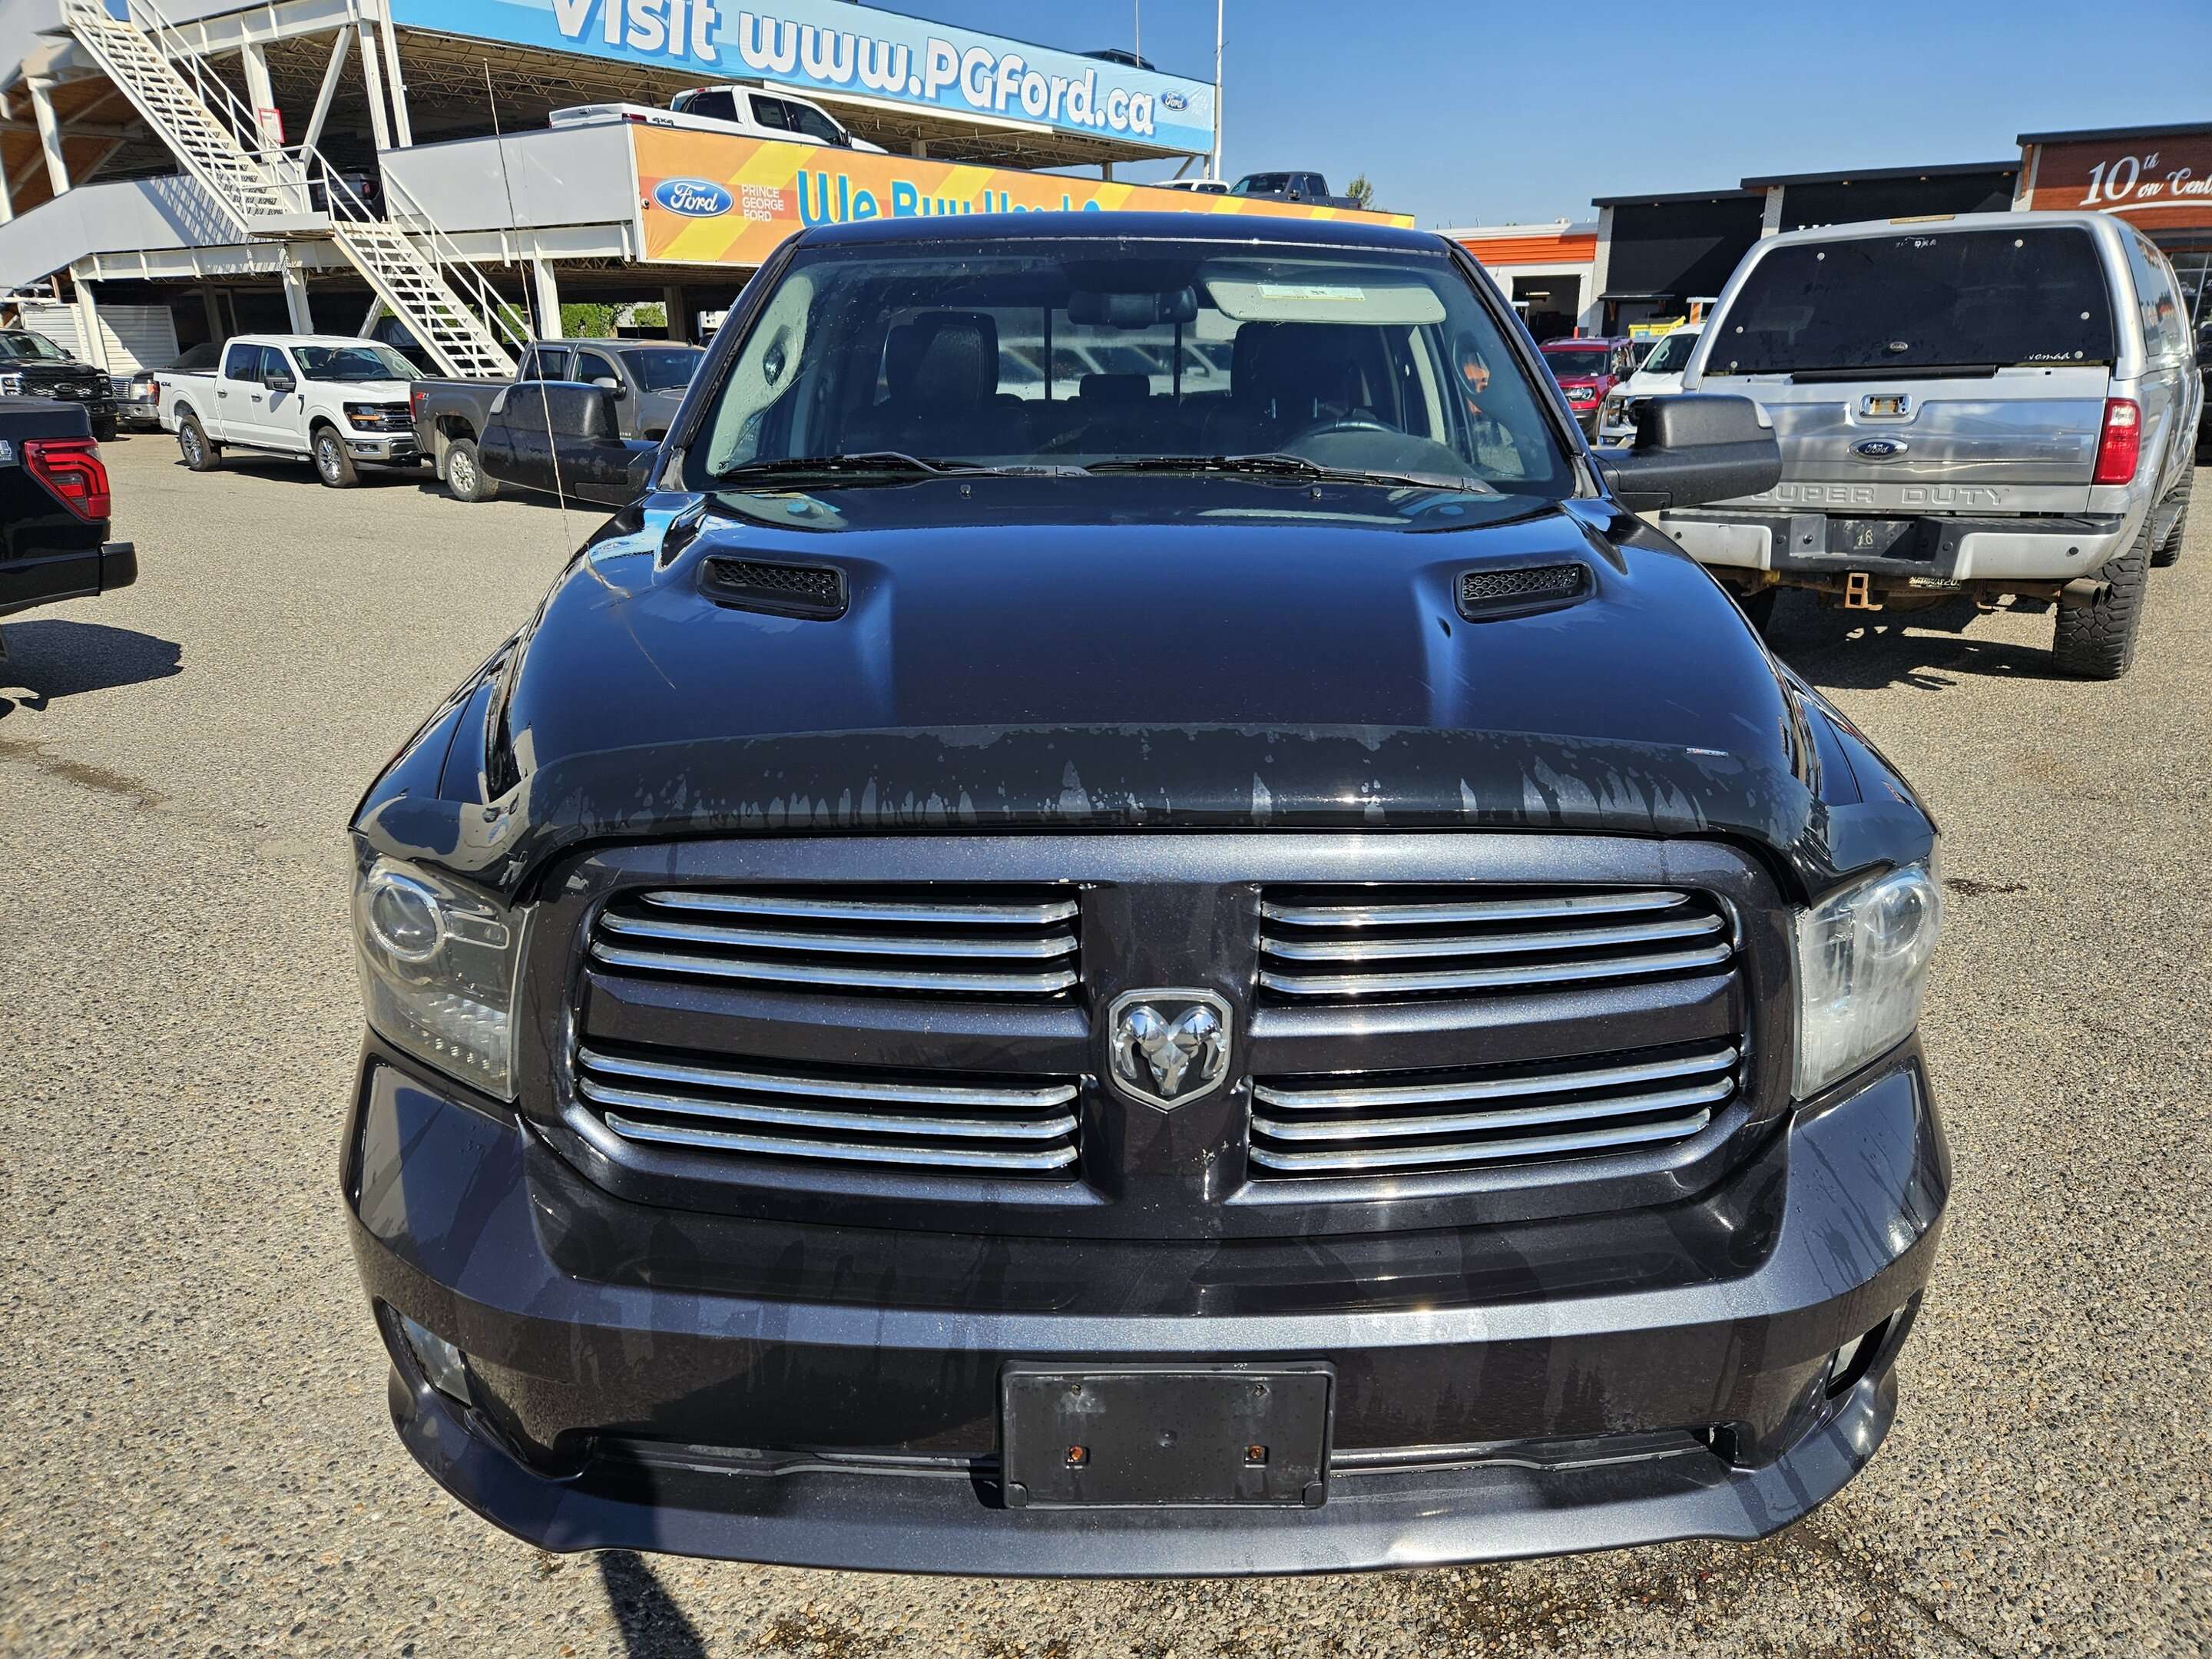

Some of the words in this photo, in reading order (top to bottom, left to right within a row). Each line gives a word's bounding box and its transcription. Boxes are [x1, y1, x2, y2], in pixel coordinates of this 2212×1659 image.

[670, 183, 719, 212] Ford
[741, 184, 780, 198] PRINCE
[2137, 183, 2164, 198] on
[742, 197, 784, 211] GEORGE
[797, 169, 878, 229] We
[743, 209, 773, 222] FORD
[1864, 443, 1889, 454] Ford
[1902, 487, 2010, 505] DUTY
